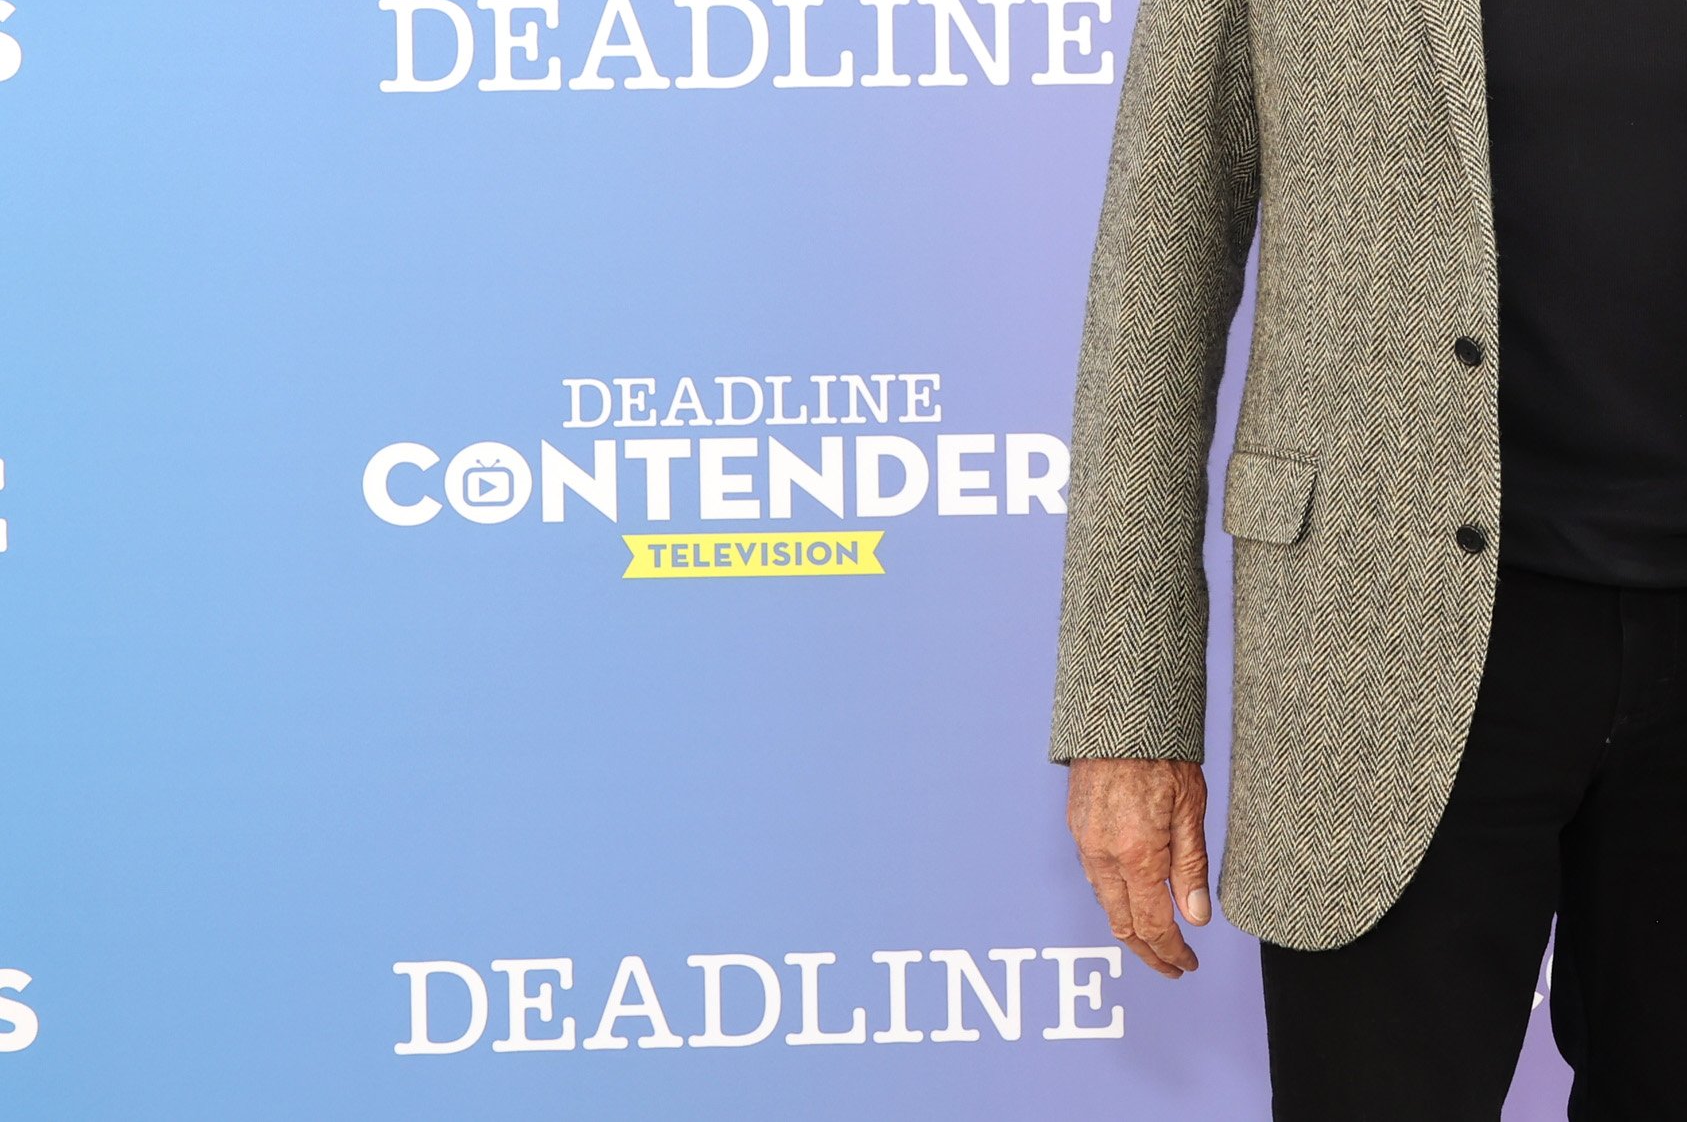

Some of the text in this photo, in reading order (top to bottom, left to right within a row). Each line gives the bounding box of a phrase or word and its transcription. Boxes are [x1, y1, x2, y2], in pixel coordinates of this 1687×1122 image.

[562, 373, 942, 429] DEADLINE
[647, 542, 860, 569] TELEVISION
[392, 946, 1125, 1055] DEADLINE
